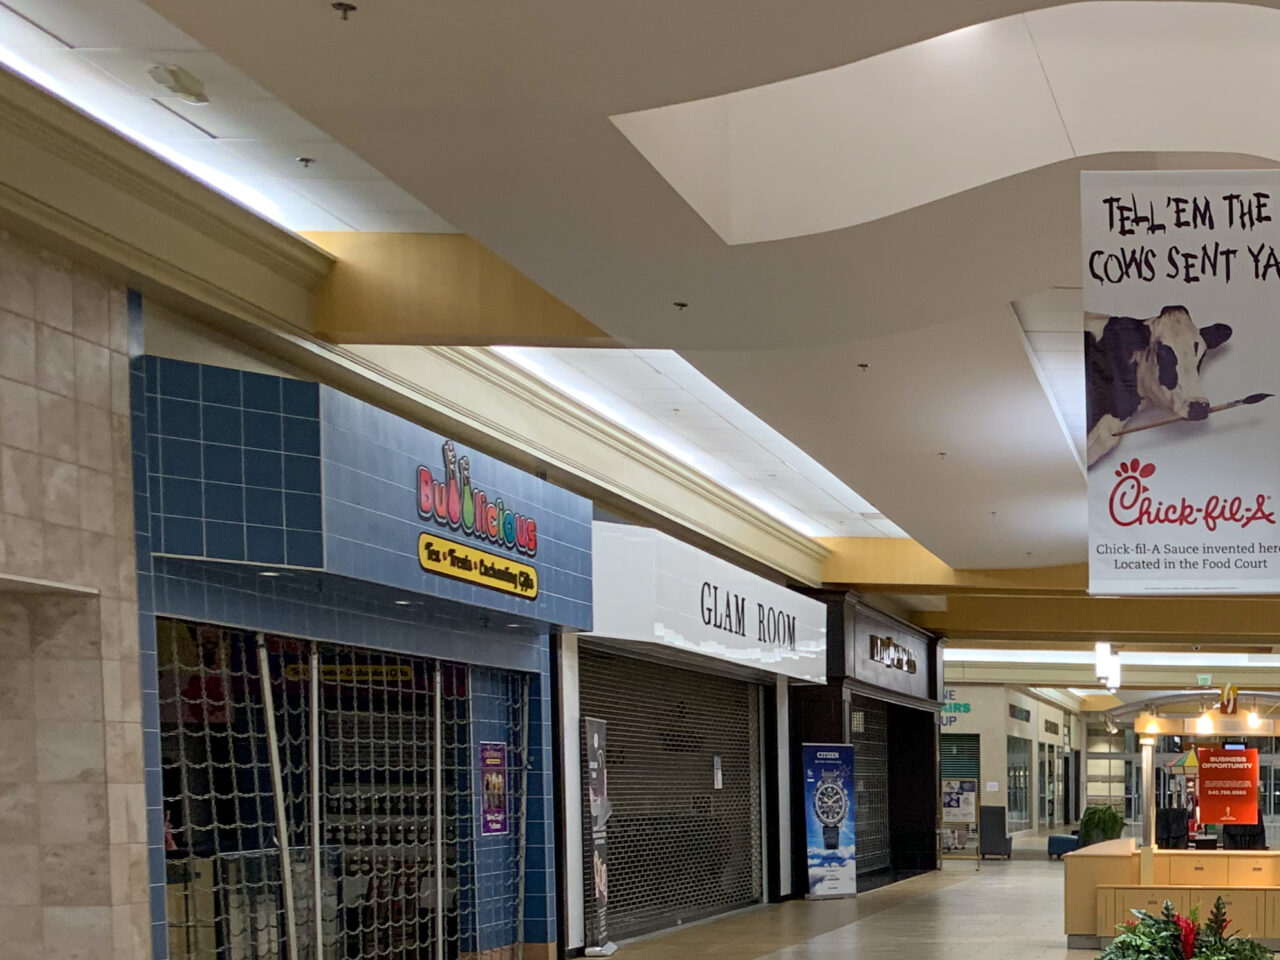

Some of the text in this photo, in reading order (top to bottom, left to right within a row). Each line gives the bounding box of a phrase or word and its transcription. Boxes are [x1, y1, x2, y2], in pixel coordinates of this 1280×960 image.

[1103, 193, 1166, 235] TELL
[1222, 192, 1271, 231] THE
[1089, 245, 1157, 286] COWS
[1166, 241, 1238, 284] SENT
[1109, 473, 1276, 532] Chick-fil-A
[1096, 543, 1160, 555] Chick-fil-A
[1163, 543, 1199, 555] Sauce
[1202, 543, 1255, 555] invented
[1114, 558, 1268, 569] Located in the Food Court
[700, 581, 796, 651] GLAM ROOM
